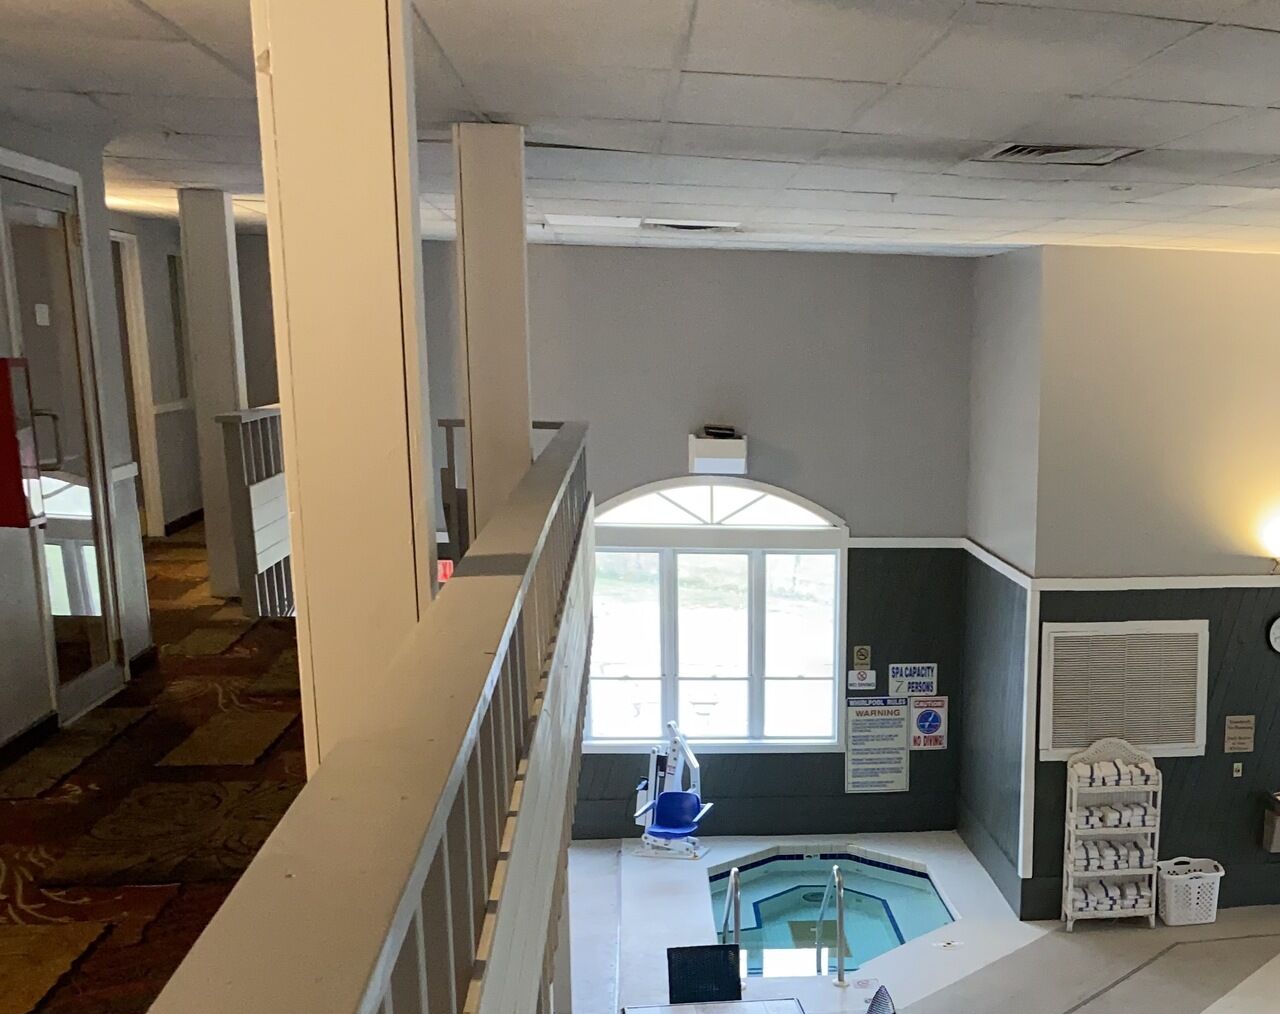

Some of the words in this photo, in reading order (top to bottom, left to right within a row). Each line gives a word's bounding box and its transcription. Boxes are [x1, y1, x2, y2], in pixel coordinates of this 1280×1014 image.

[892, 666, 903, 678] SPA
[904, 666, 934, 678] CAPACITY
[907, 681, 934, 692] PERSONS
[856, 709, 900, 717] WARNING
[913, 736, 922, 746] NO
